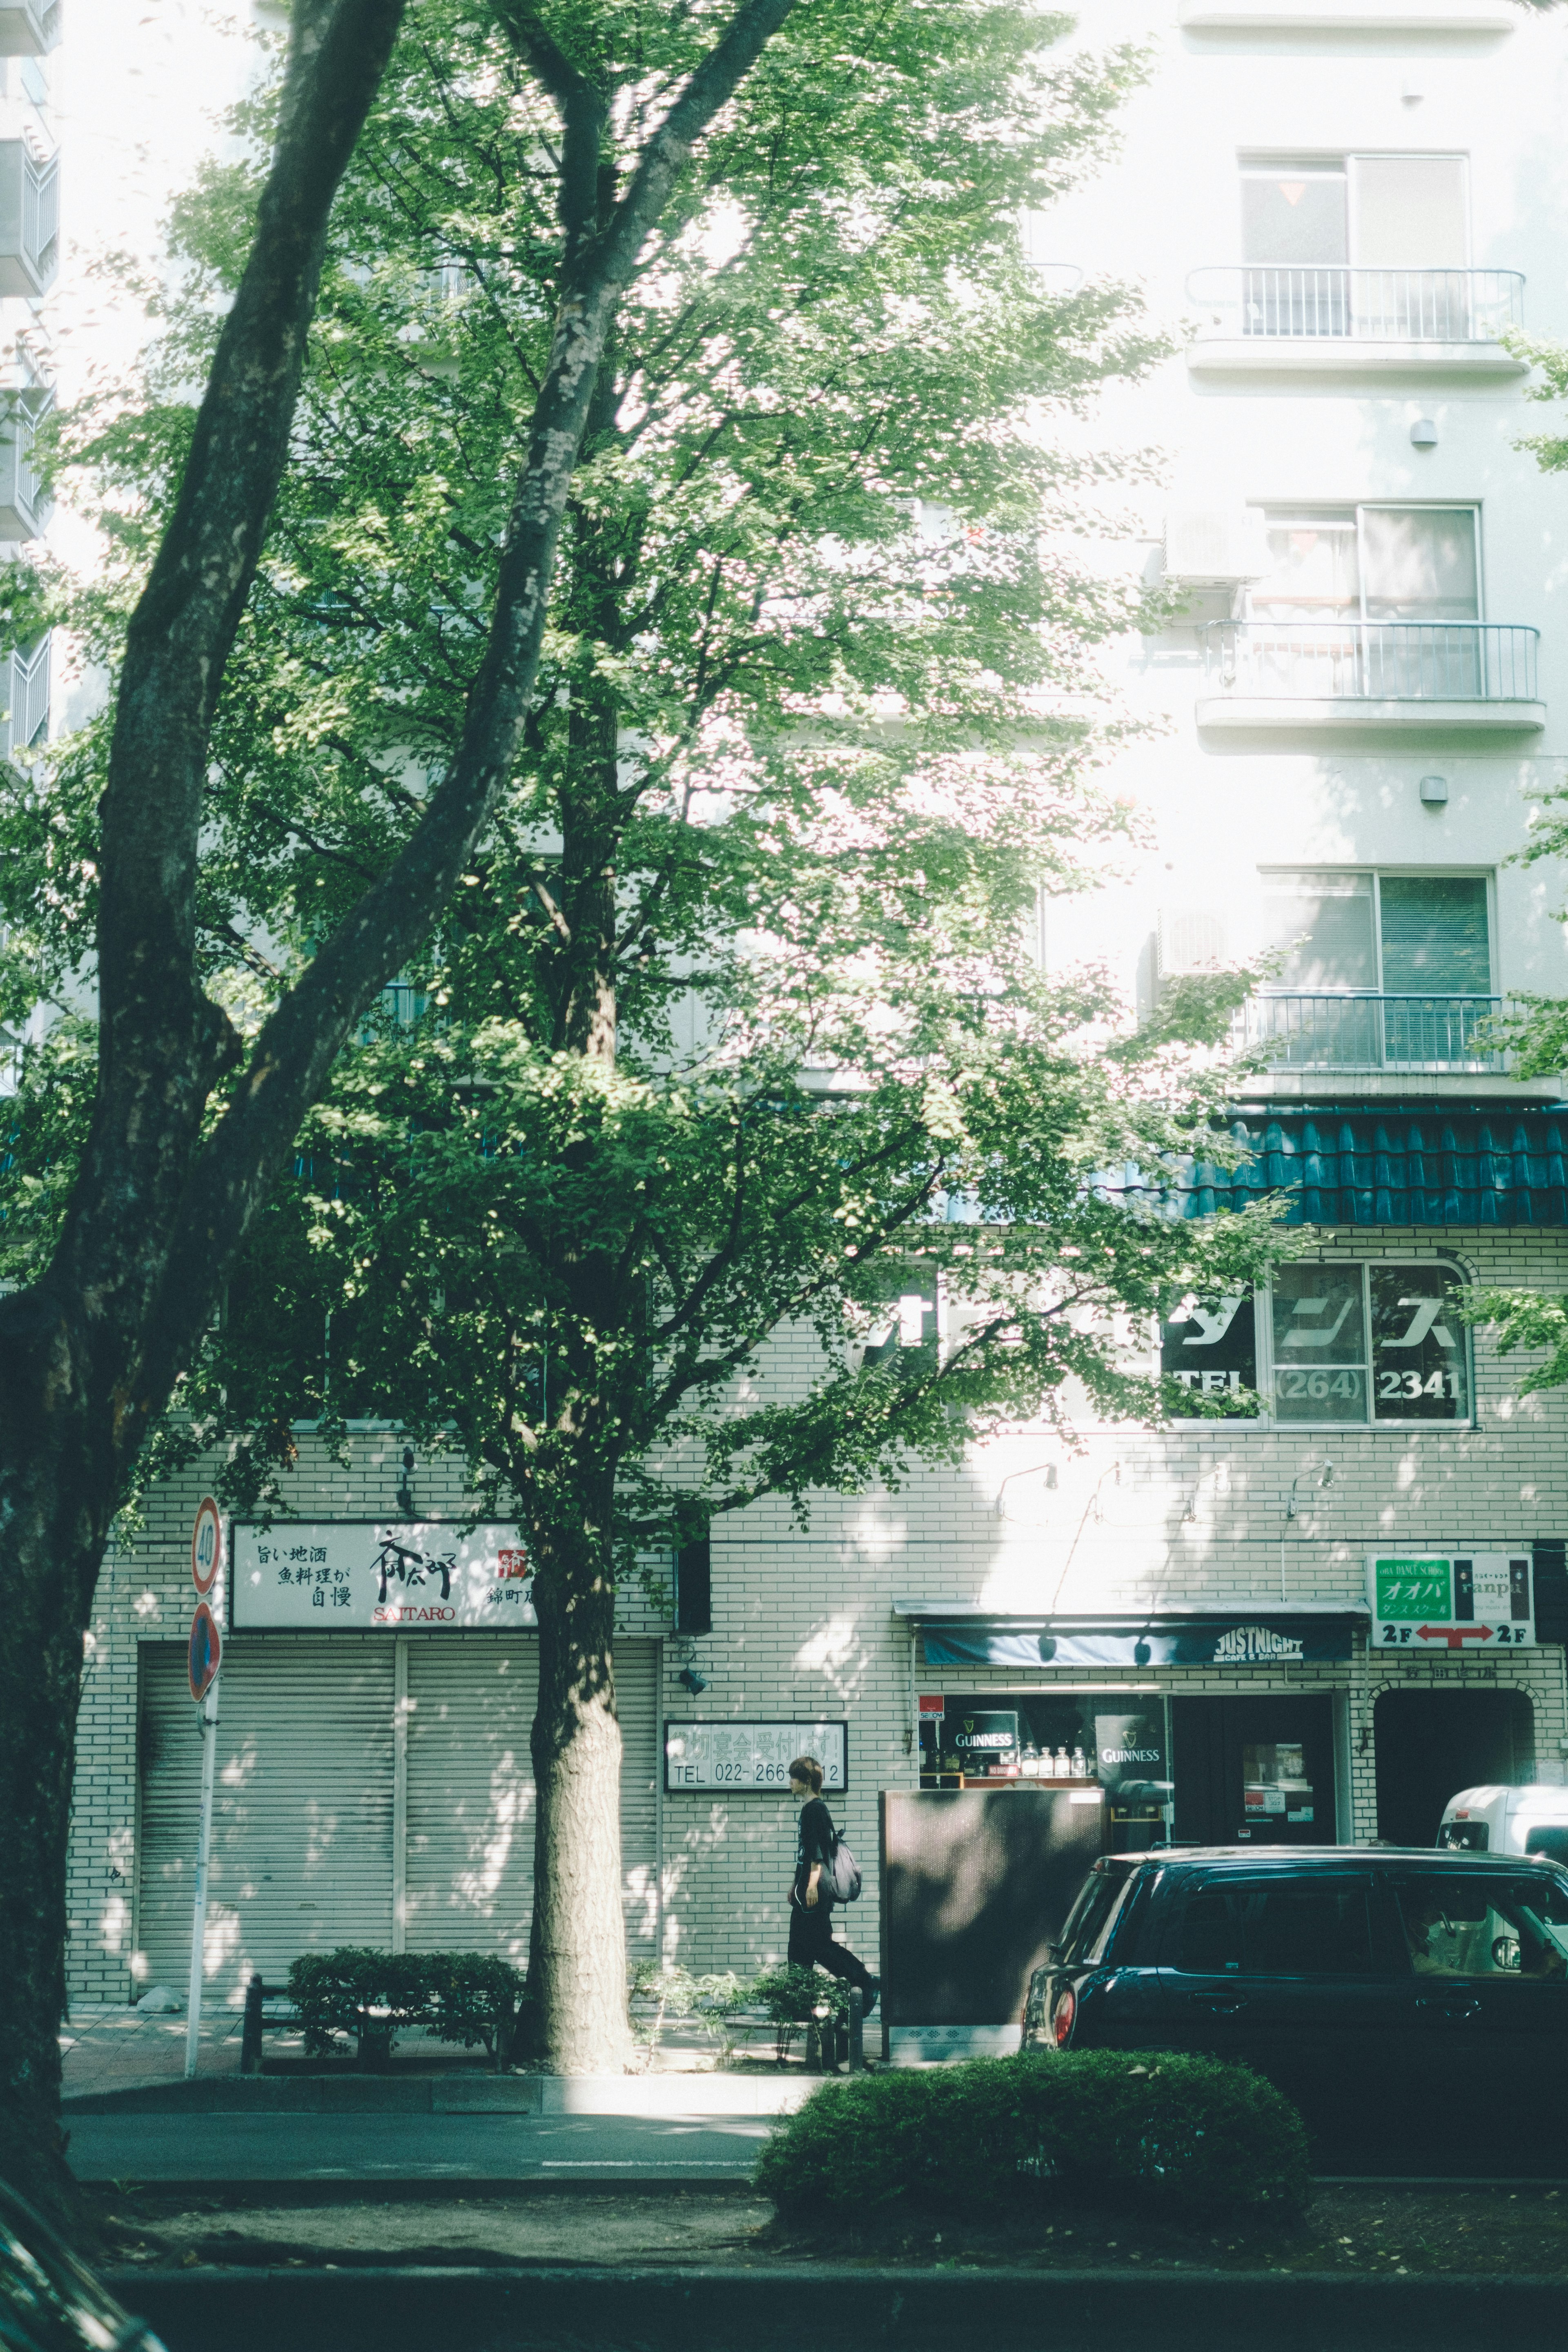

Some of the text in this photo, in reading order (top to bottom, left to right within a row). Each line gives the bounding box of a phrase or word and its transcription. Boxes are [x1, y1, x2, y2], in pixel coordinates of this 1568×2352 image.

[1277, 1371, 1360, 1399] (264)
[1380, 1371, 1460, 1399] 2341
[197, 1525, 213, 1567] 40
[258, 1546, 327, 1564] 旨い地酒
[278, 1567, 350, 1586] 魚料理が
[313, 1586, 351, 1607] 自慢
[1383, 1581, 1446, 1600] オオバ
[1462, 1583, 1522, 1598] ranpu
[374, 1607, 455, 1621] SAITARO
[1383, 1625, 1412, 1643] 2F
[1497, 1625, 1526, 1643] 2F
[956, 1733, 1012, 1747] GUINNESS
[1102, 1748, 1160, 1763] GUINNESS
[675, 1763, 838, 1783] TEL 022-266-12
